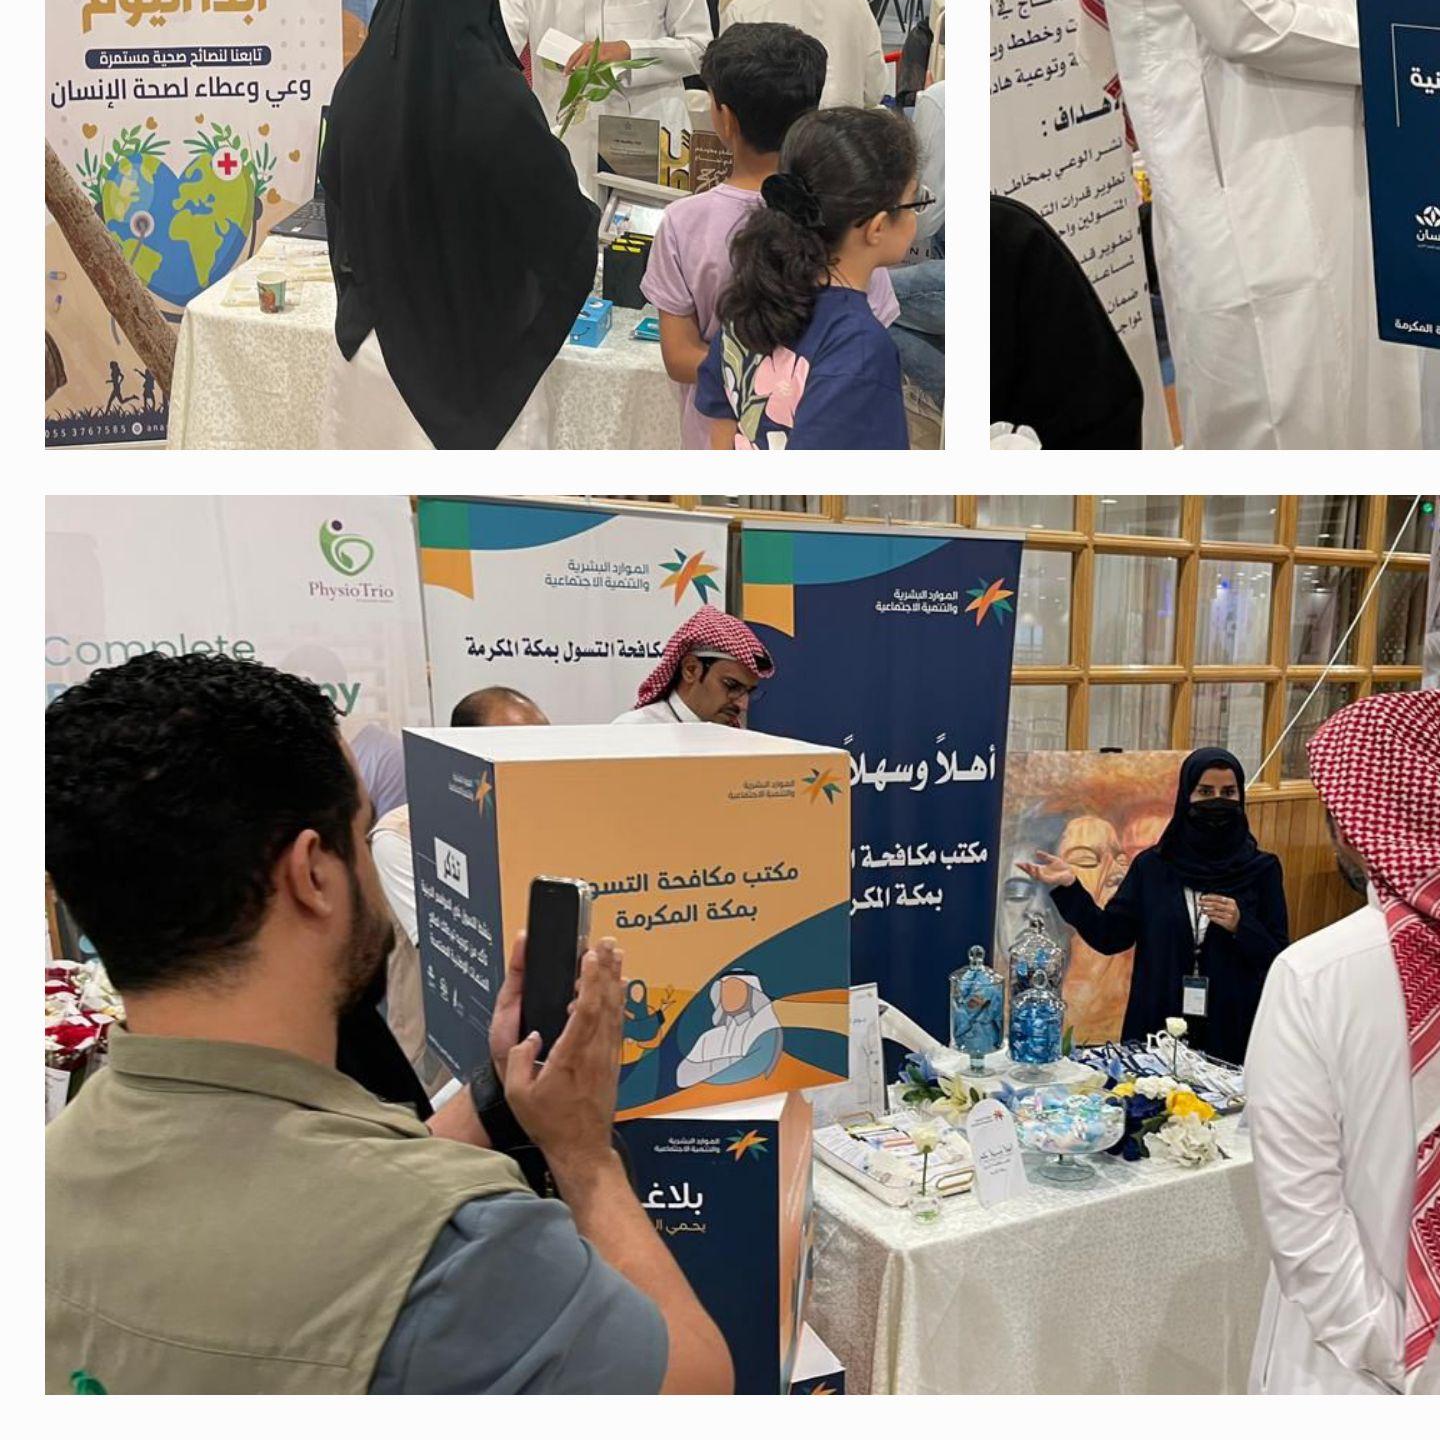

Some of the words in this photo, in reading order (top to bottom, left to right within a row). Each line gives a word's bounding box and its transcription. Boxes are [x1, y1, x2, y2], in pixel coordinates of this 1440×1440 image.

[99, 49, 150, 67] مستمرة
[150, 50, 187, 68] صحية
[190, 48, 228, 68] لنصائح
[229, 47, 263, 65] تابعنا
[51, 78, 127, 109] الإنسان
[132, 77, 189, 100] لصحة
[195, 76, 260, 102] وعطاء
[265, 78, 312, 108] وعي
[1054, 149, 1093, 180] الوعي
[1395, 317, 1433, 333] المكرمة
[567, 559, 611, 574] البشرية
[612, 562, 650, 575] الموارد
[308, 581, 394, 602] PhysioTrio
[544, 573, 603, 588] الاجتماعية
[604, 576, 650, 592] والتنمية
[893, 589, 927, 602] البشرية
[927, 590, 958, 604] الموارد
[465, 636, 519, 661] المكرمة
[522, 637, 559, 664] بمكة
[563, 640, 614, 662] التسول
[934, 732, 996, 785] أهلاً
[860, 841, 937, 870] مكافحة
[939, 840, 988, 872] مكتب
[658, 866, 737, 892] مكافحة
[742, 861, 799, 887] مكتب
[590, 873, 649, 900] التسو
[895, 882, 944, 913] بمكة
[615, 903, 698, 931] المكرمة
[707, 902, 758, 923] بمكة
[641, 1181, 703, 1215] بلاغ
